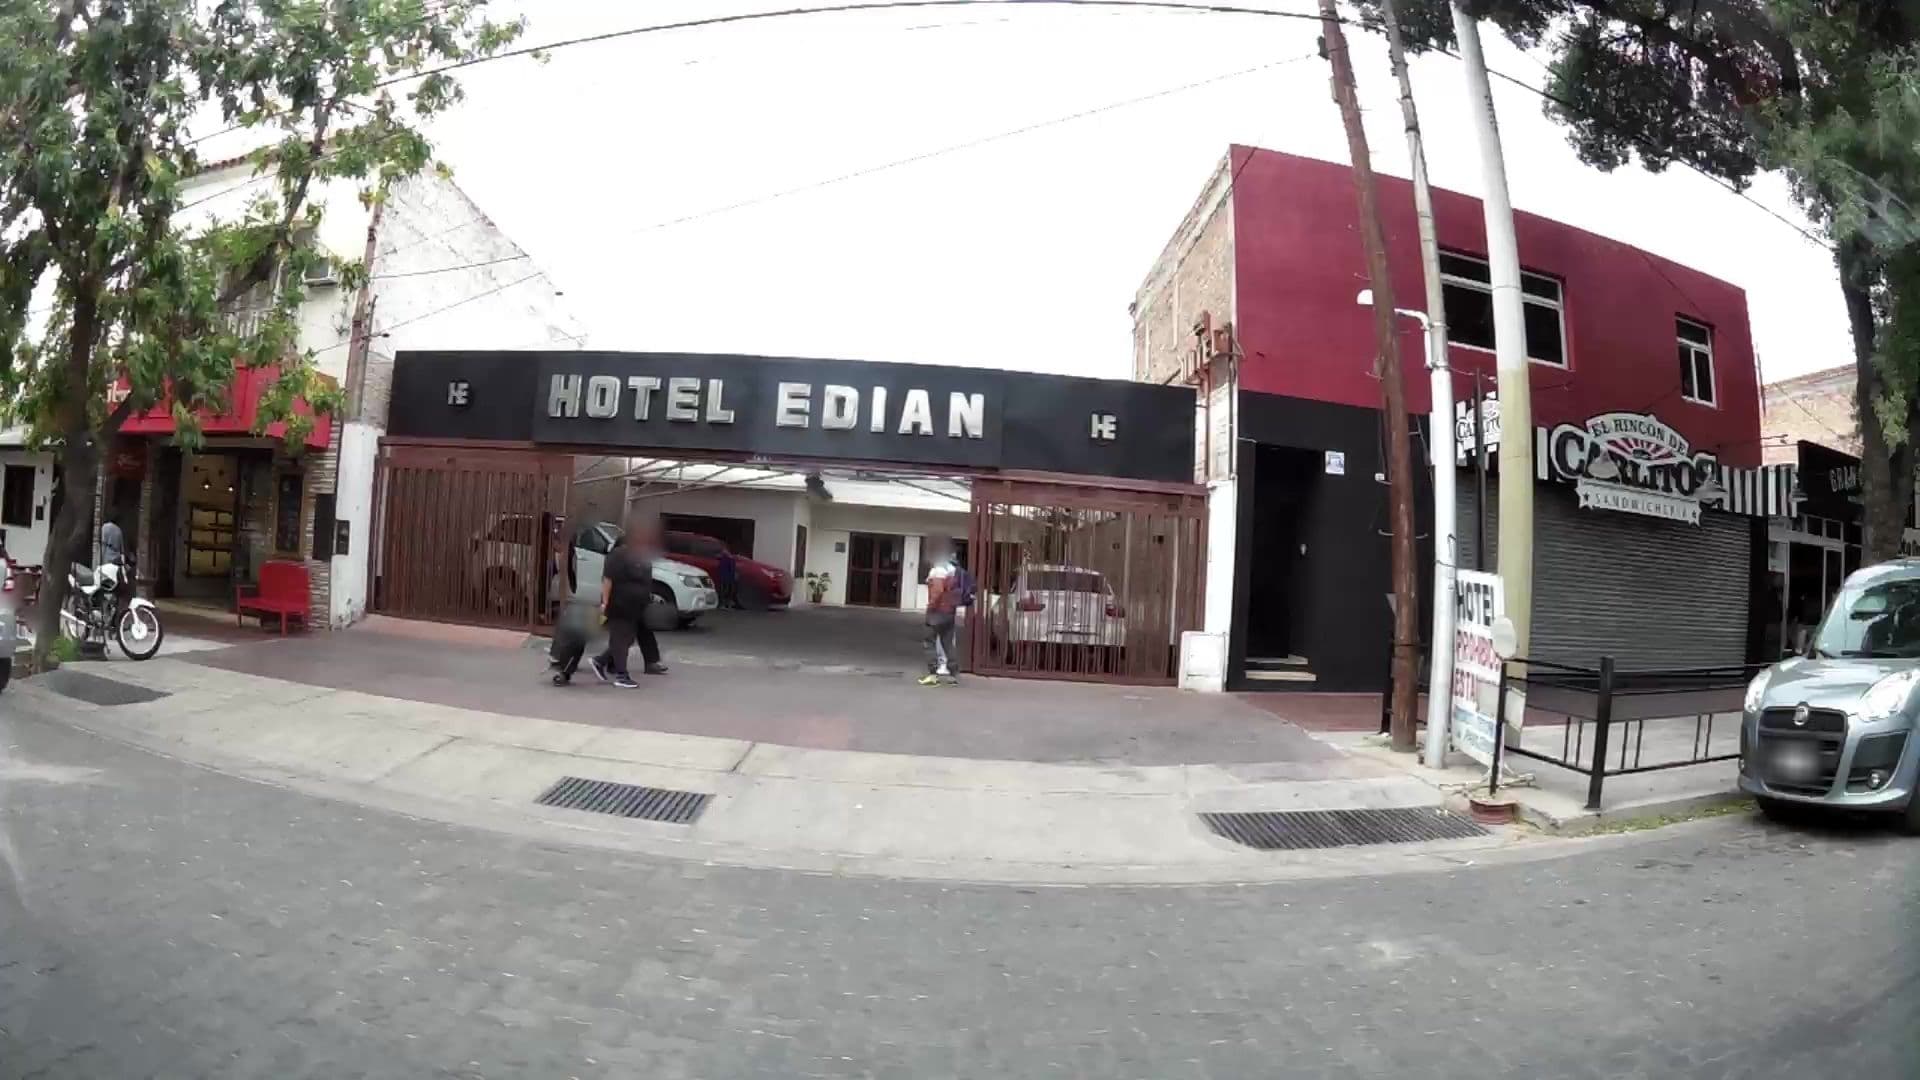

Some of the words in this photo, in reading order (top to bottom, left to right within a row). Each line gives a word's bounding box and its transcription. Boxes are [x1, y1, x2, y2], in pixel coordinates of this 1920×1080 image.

[548, 373, 735, 424] HOTEL
[776, 381, 984, 439] EDIAN
[1592, 420, 1610, 438] EL
[1669, 433, 1687, 455] DE
